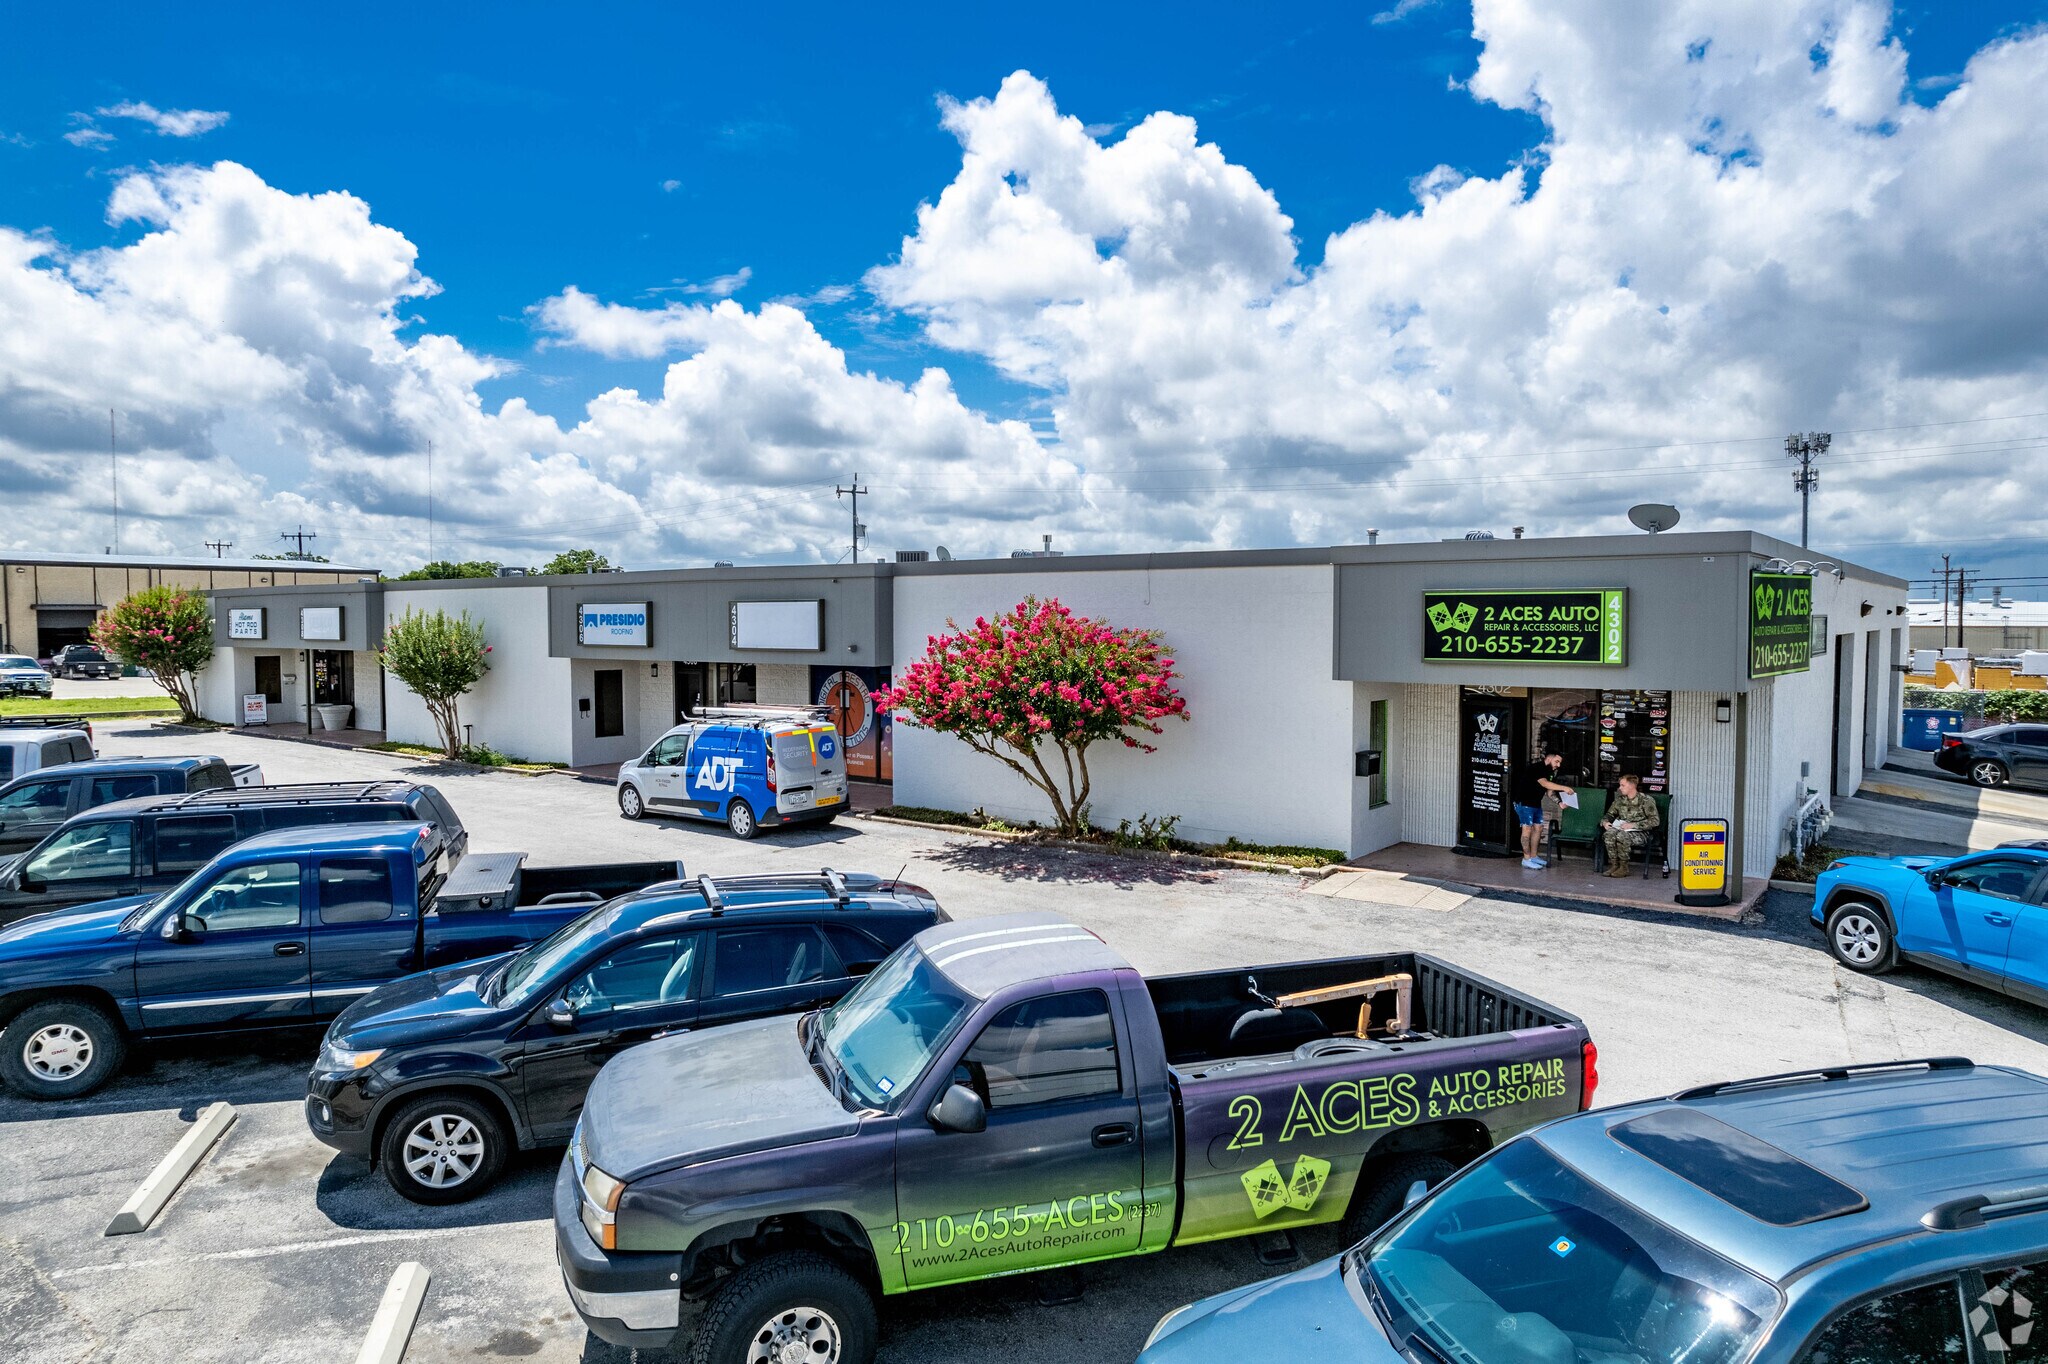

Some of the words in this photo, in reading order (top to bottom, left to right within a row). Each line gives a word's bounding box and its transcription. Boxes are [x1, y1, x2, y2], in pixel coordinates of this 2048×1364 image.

[1484, 607, 1494, 621] 2
[1499, 606, 1542, 621] ACES
[1548, 606, 1600, 621] AUTO
[1776, 589, 1783, 616] 2
[1785, 588, 1808, 616] ACES
[600, 614, 645, 626] PRESIDIO
[1484, 624, 1510, 632] REPAIR
[1513, 624, 1520, 632] &
[1522, 624, 1582, 633] ACCESSORIES,
[1608, 596, 1620, 660] 4302
[1441, 636, 1584, 654] 210-655-2237
[1755, 642, 1808, 668] 210-655-2237
[822, 742, 832, 752] ADT
[1475, 732, 1480, 742] 2
[1481, 733, 1500, 744] ACES
[784, 750, 808, 760] SECURITY
[694, 756, 744, 792] ADT
[1428, 1069, 1490, 1098] AUTO
[1498, 1058, 1565, 1086] REPAIR
[1227, 1095, 1264, 1150] 2
[1279, 1073, 1420, 1142] ACES
[1428, 1100, 1442, 1118] &
[1447, 1079, 1566, 1116] ACCESSORIES
[912, 1225, 1126, 1268] www.2AcesAutoRepair.com
